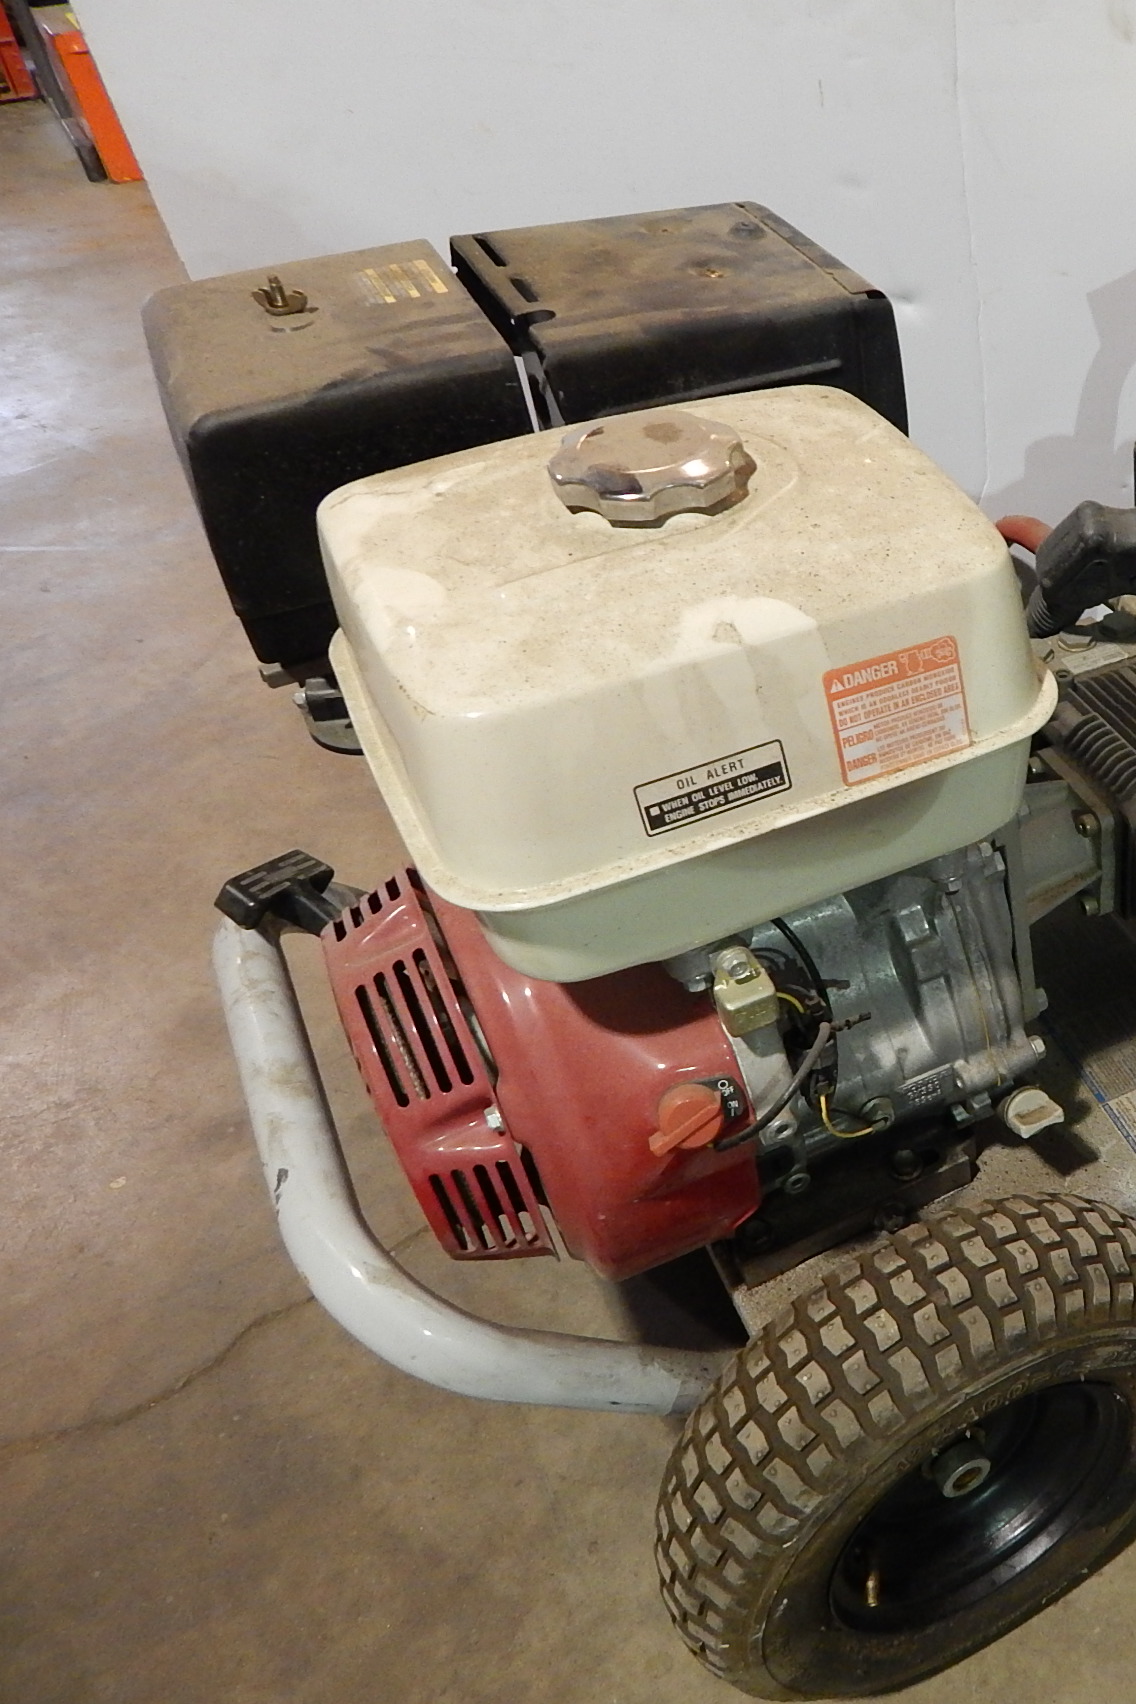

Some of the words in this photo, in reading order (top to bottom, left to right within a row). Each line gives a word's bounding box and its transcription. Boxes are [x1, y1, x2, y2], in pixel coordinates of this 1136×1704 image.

[843, 660, 899, 689] DANGER
[863, 704, 891, 720] OPERATE
[841, 729, 874, 749] PELIGRO
[676, 776, 697, 790] OIL
[706, 758, 745, 781] ALERT
[845, 752, 878, 773] DANGER
[661, 796, 689, 812] WHEN
[691, 790, 705, 802] OIL
[708, 781, 734, 797] LEVEL
[664, 807, 696, 823] ENGINE
[698, 796, 726, 812] STOPS
